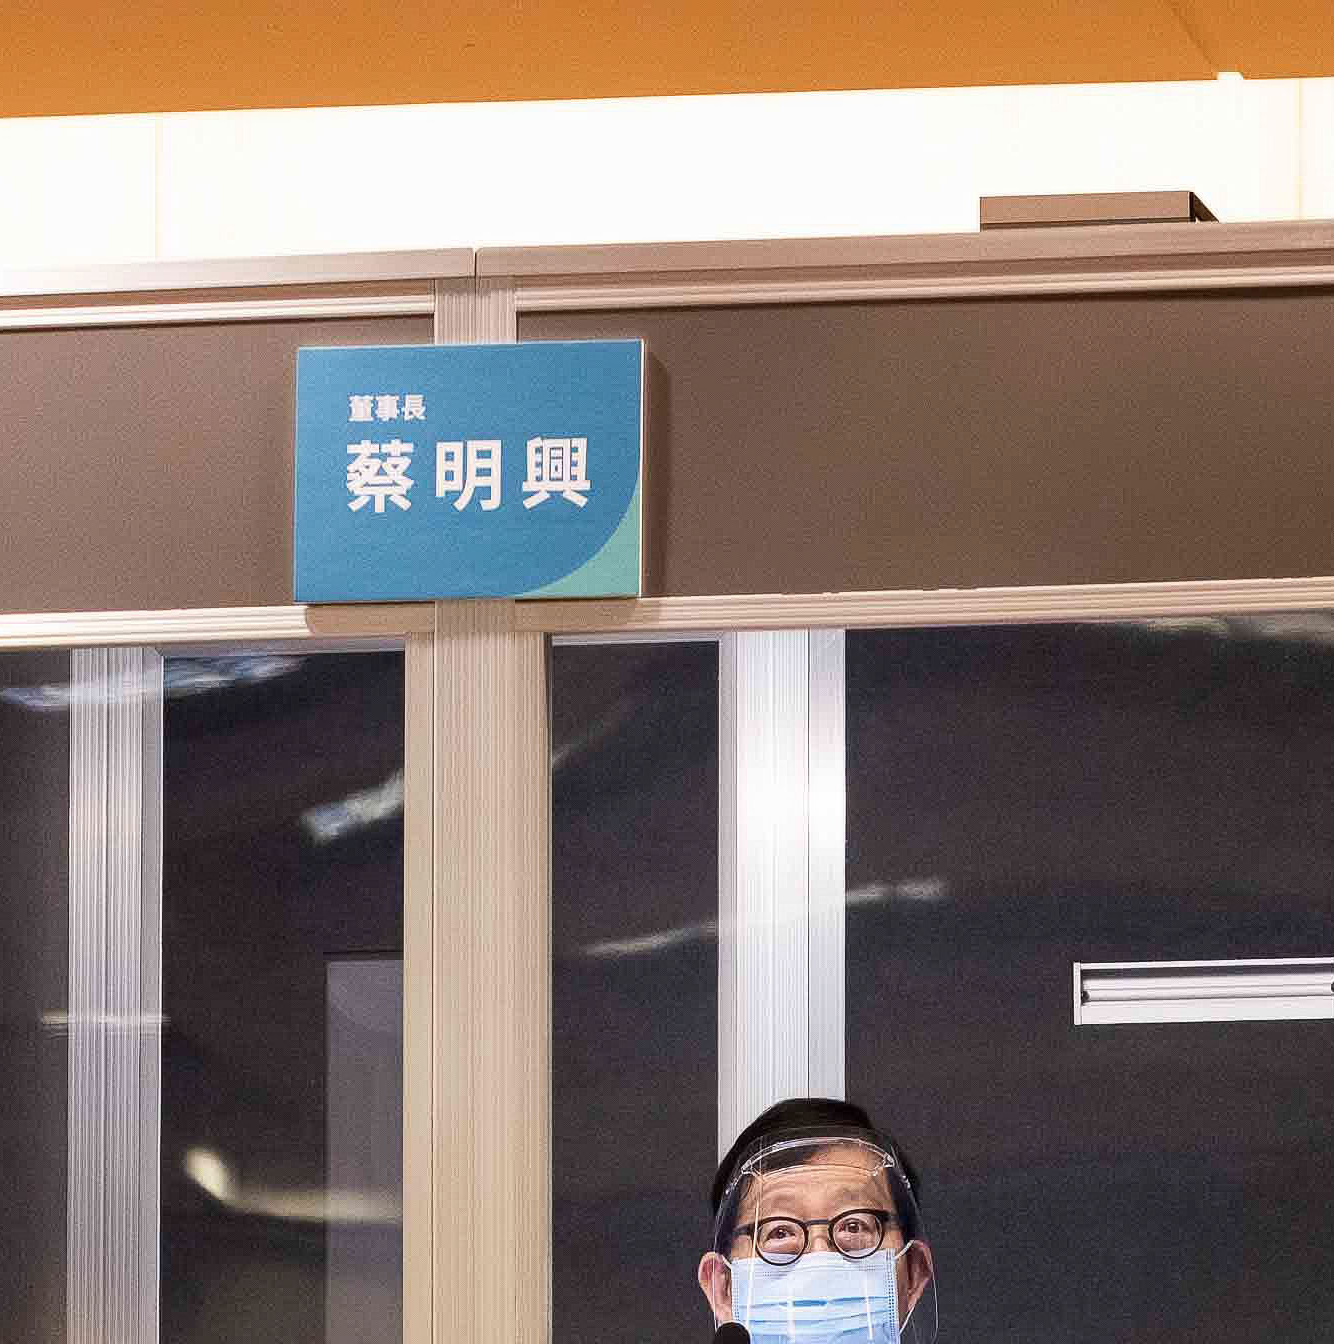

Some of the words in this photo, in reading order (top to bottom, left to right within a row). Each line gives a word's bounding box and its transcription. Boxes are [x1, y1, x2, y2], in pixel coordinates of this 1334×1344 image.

[347, 394, 427, 423] 董事長
[346, 436, 592, 513] 蔡明興
